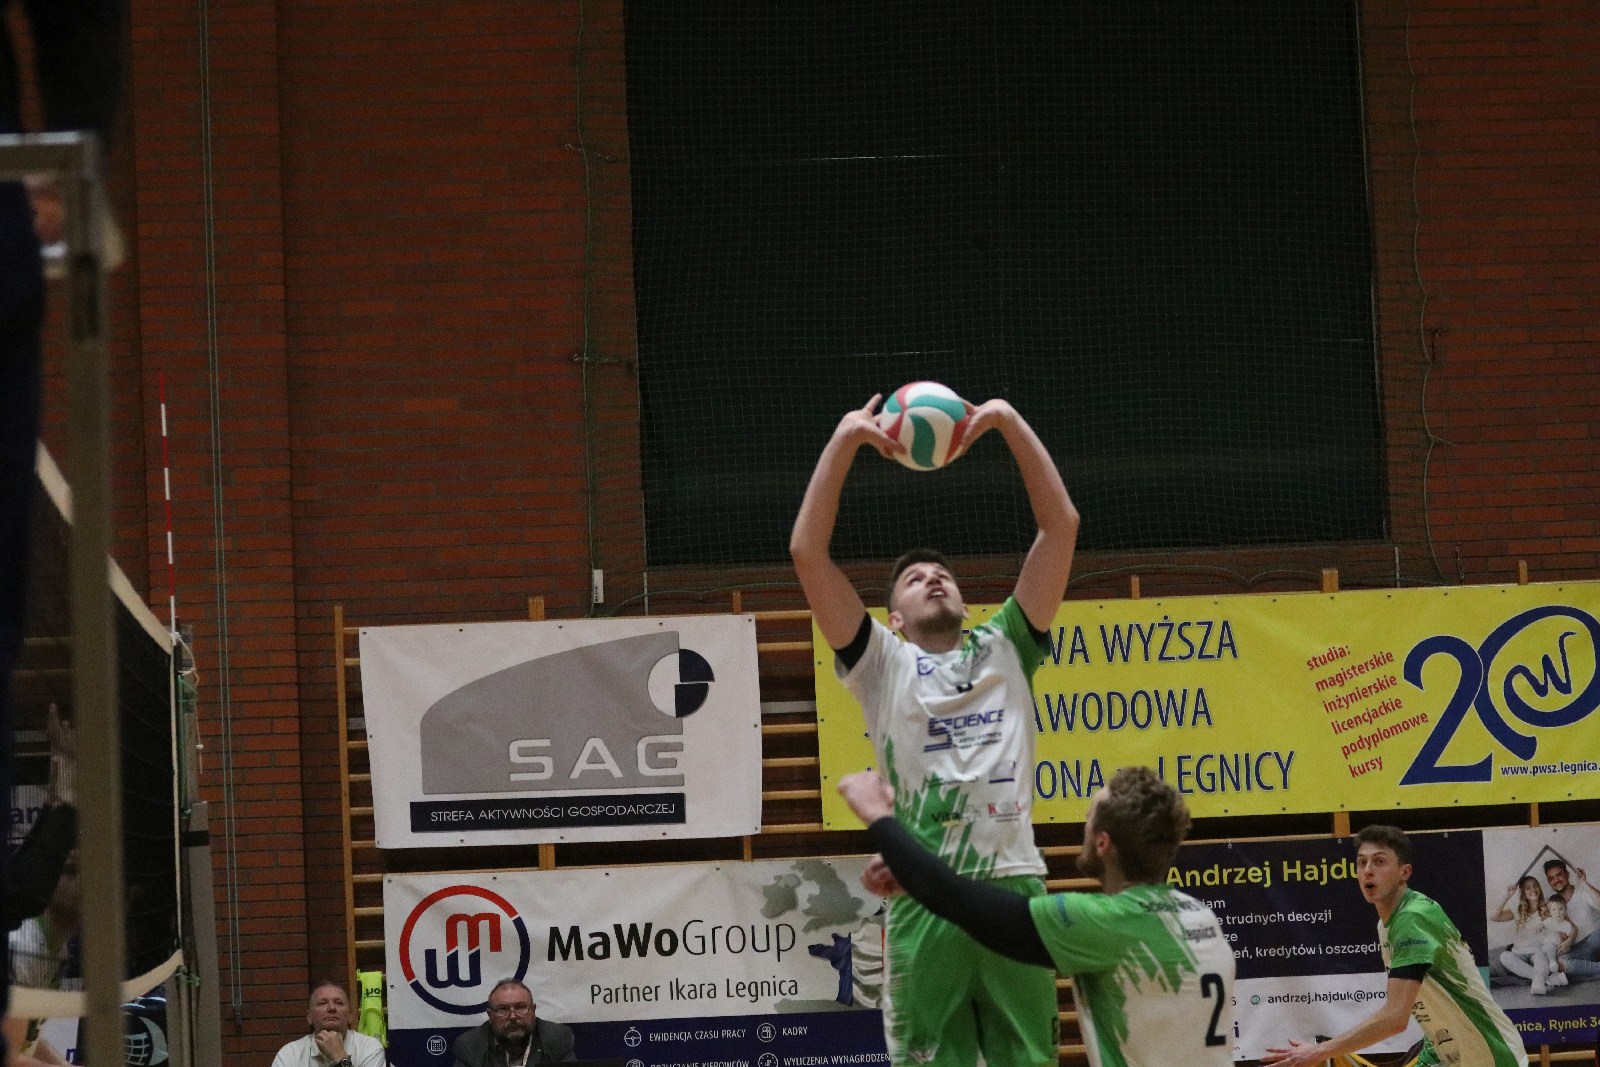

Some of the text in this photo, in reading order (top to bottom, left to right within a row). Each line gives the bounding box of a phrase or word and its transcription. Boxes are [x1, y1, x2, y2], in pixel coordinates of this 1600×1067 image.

[1099, 614, 1238, 663] WYŻSZA
[1306, 644, 1351, 671] studia:
[1315, 650, 1395, 692] magisterskie
[1322, 674, 1398, 714] inżynierskie
[1330, 697, 1403, 735] licencjackie
[1340, 711, 1429, 760] podyplomowe
[508, 733, 685, 782] SAG
[1348, 755, 1384, 778] kursy
[430, 803, 676, 822] STREFA AKTYWNOŚCI GOSPODARCZEJ
[1166, 861, 1272, 888] Andrzej
[1226, 912, 1285, 926] trudnych
[1287, 909, 1332, 924] decyzji
[546, 919, 796, 963] MaWoGroup
[1255, 943, 1316, 958] kredytów
[590, 976, 799, 1004] Partner Ikara Legnica
[1267, 990, 1388, 1005] andrzej.hajduk@pro
[1201, 973, 1227, 1047] 2
[649, 1028, 746, 1042] EWIDENCJA CZASU PRACY
[782, 1026, 808, 1036] KADRY
[1549, 1018, 1588, 1032] Rynek
[783, 1055, 829, 1066] WYLICZENIA
